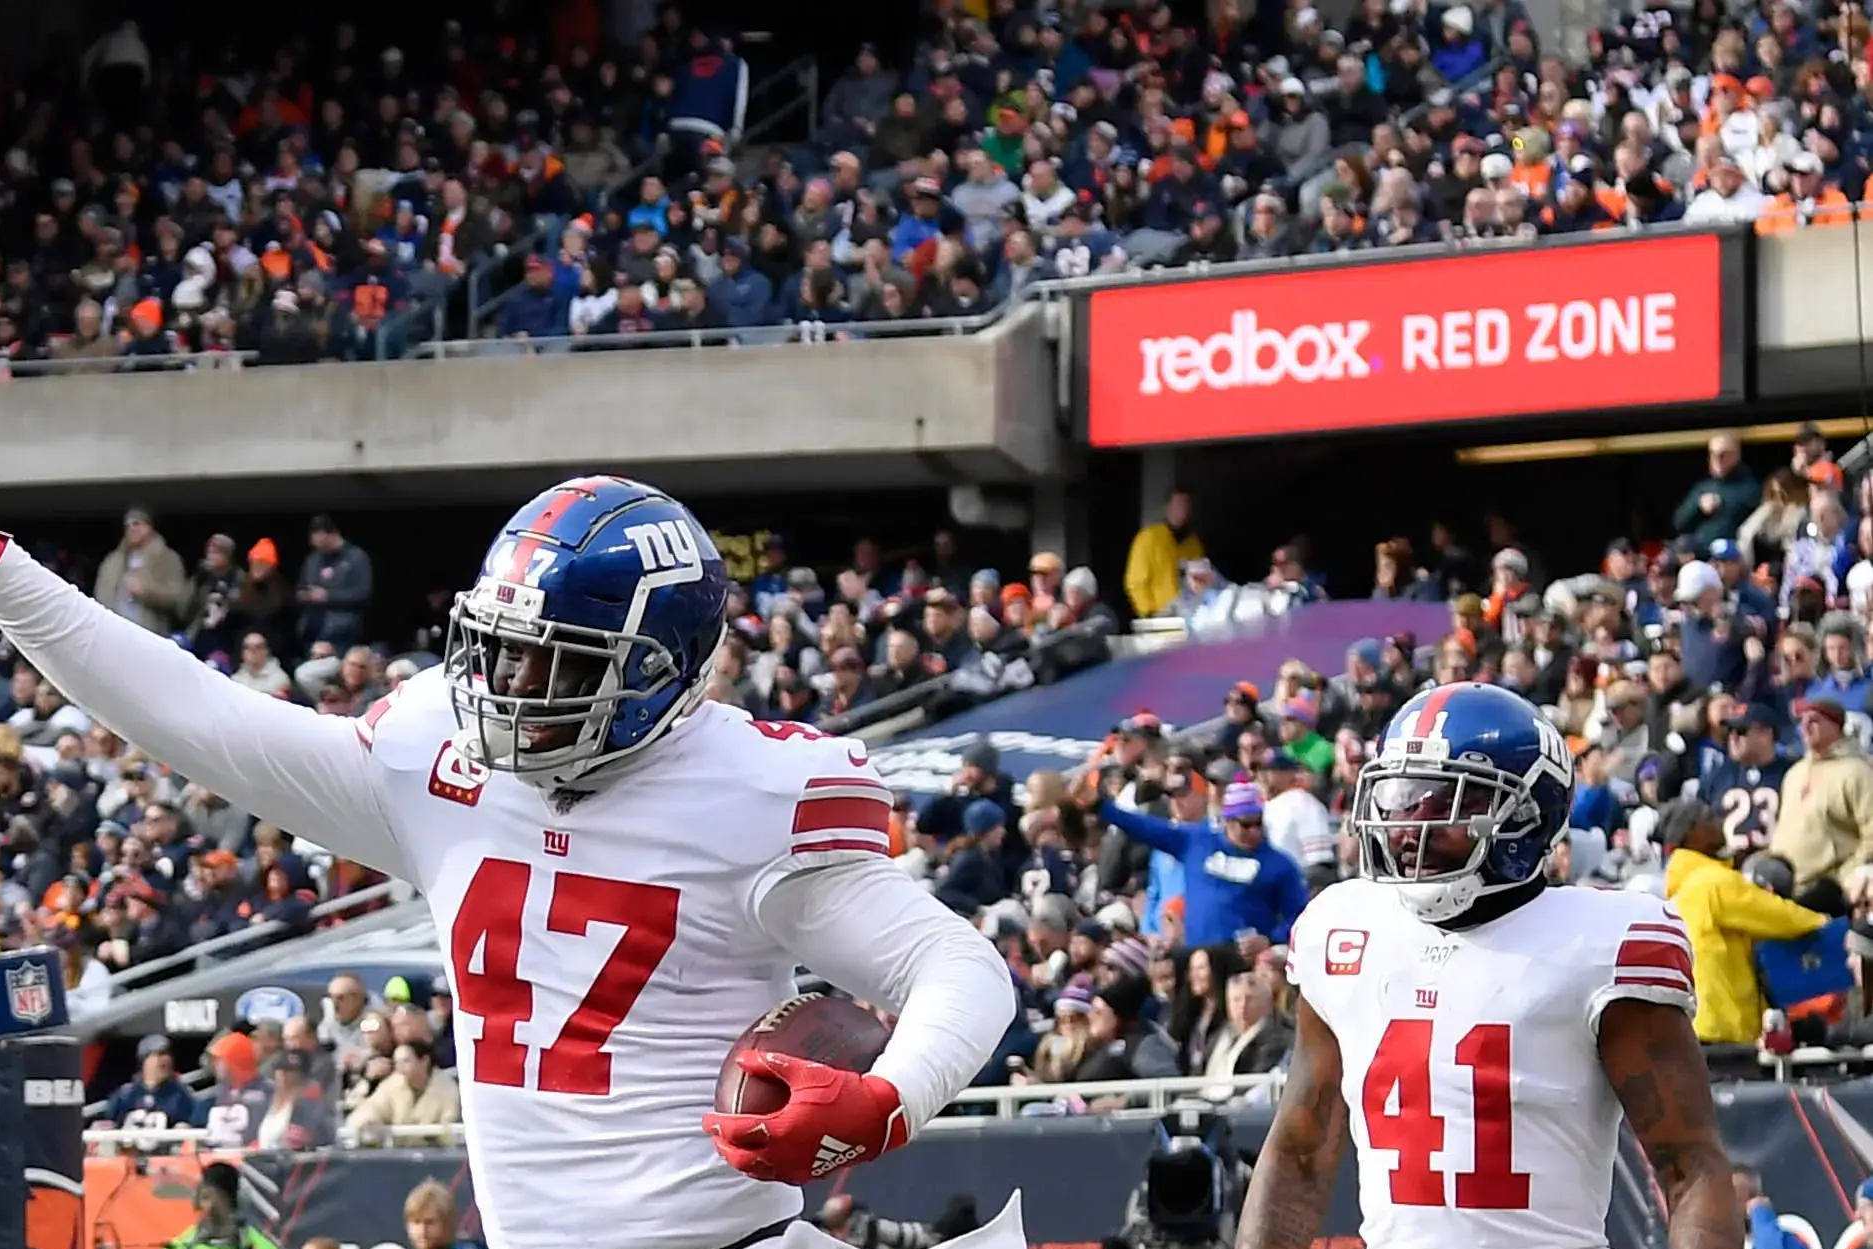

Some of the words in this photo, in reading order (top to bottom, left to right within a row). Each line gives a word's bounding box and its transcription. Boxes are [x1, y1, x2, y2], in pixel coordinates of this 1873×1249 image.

[1401, 308, 1510, 371] RED
[1525, 293, 1676, 360] ZONE
[486, 540, 558, 589] 47
[1722, 786, 1780, 851] 23
[543, 829, 571, 858] ny
[1326, 931, 1367, 966] C
[450, 856, 681, 1095] 47
[15, 988, 48, 1015] NFL
[1415, 989, 1439, 1010] ny
[1361, 1018, 1531, 1209] 41
[811, 1144, 868, 1178] adidas
